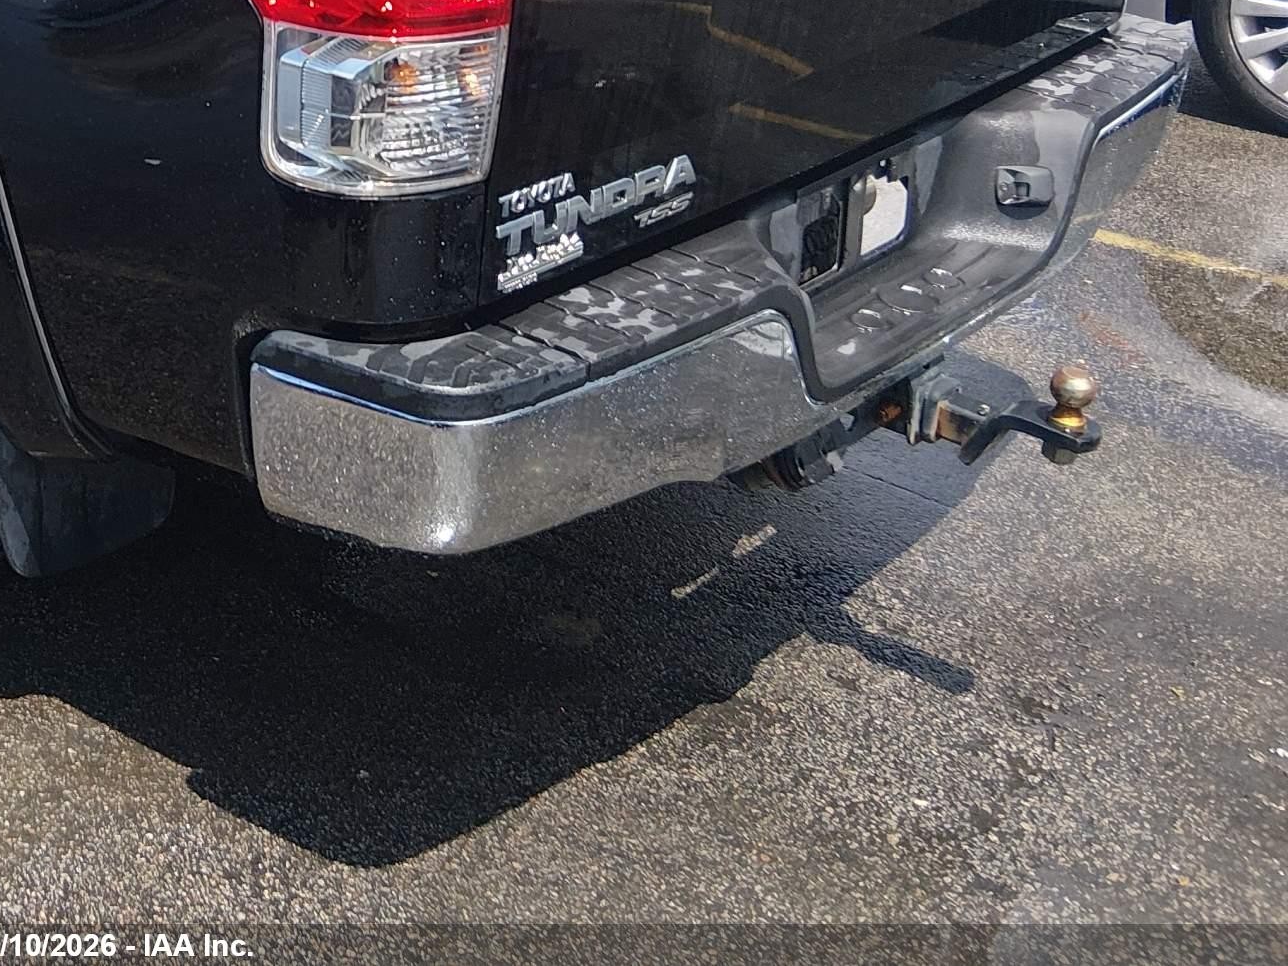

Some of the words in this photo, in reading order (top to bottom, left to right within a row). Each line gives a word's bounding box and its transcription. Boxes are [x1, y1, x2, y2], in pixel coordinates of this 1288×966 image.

[496, 154, 697, 257] TUNDRA
[498, 172, 576, 218] TOYOTA
[634, 191, 694, 228] TSS
